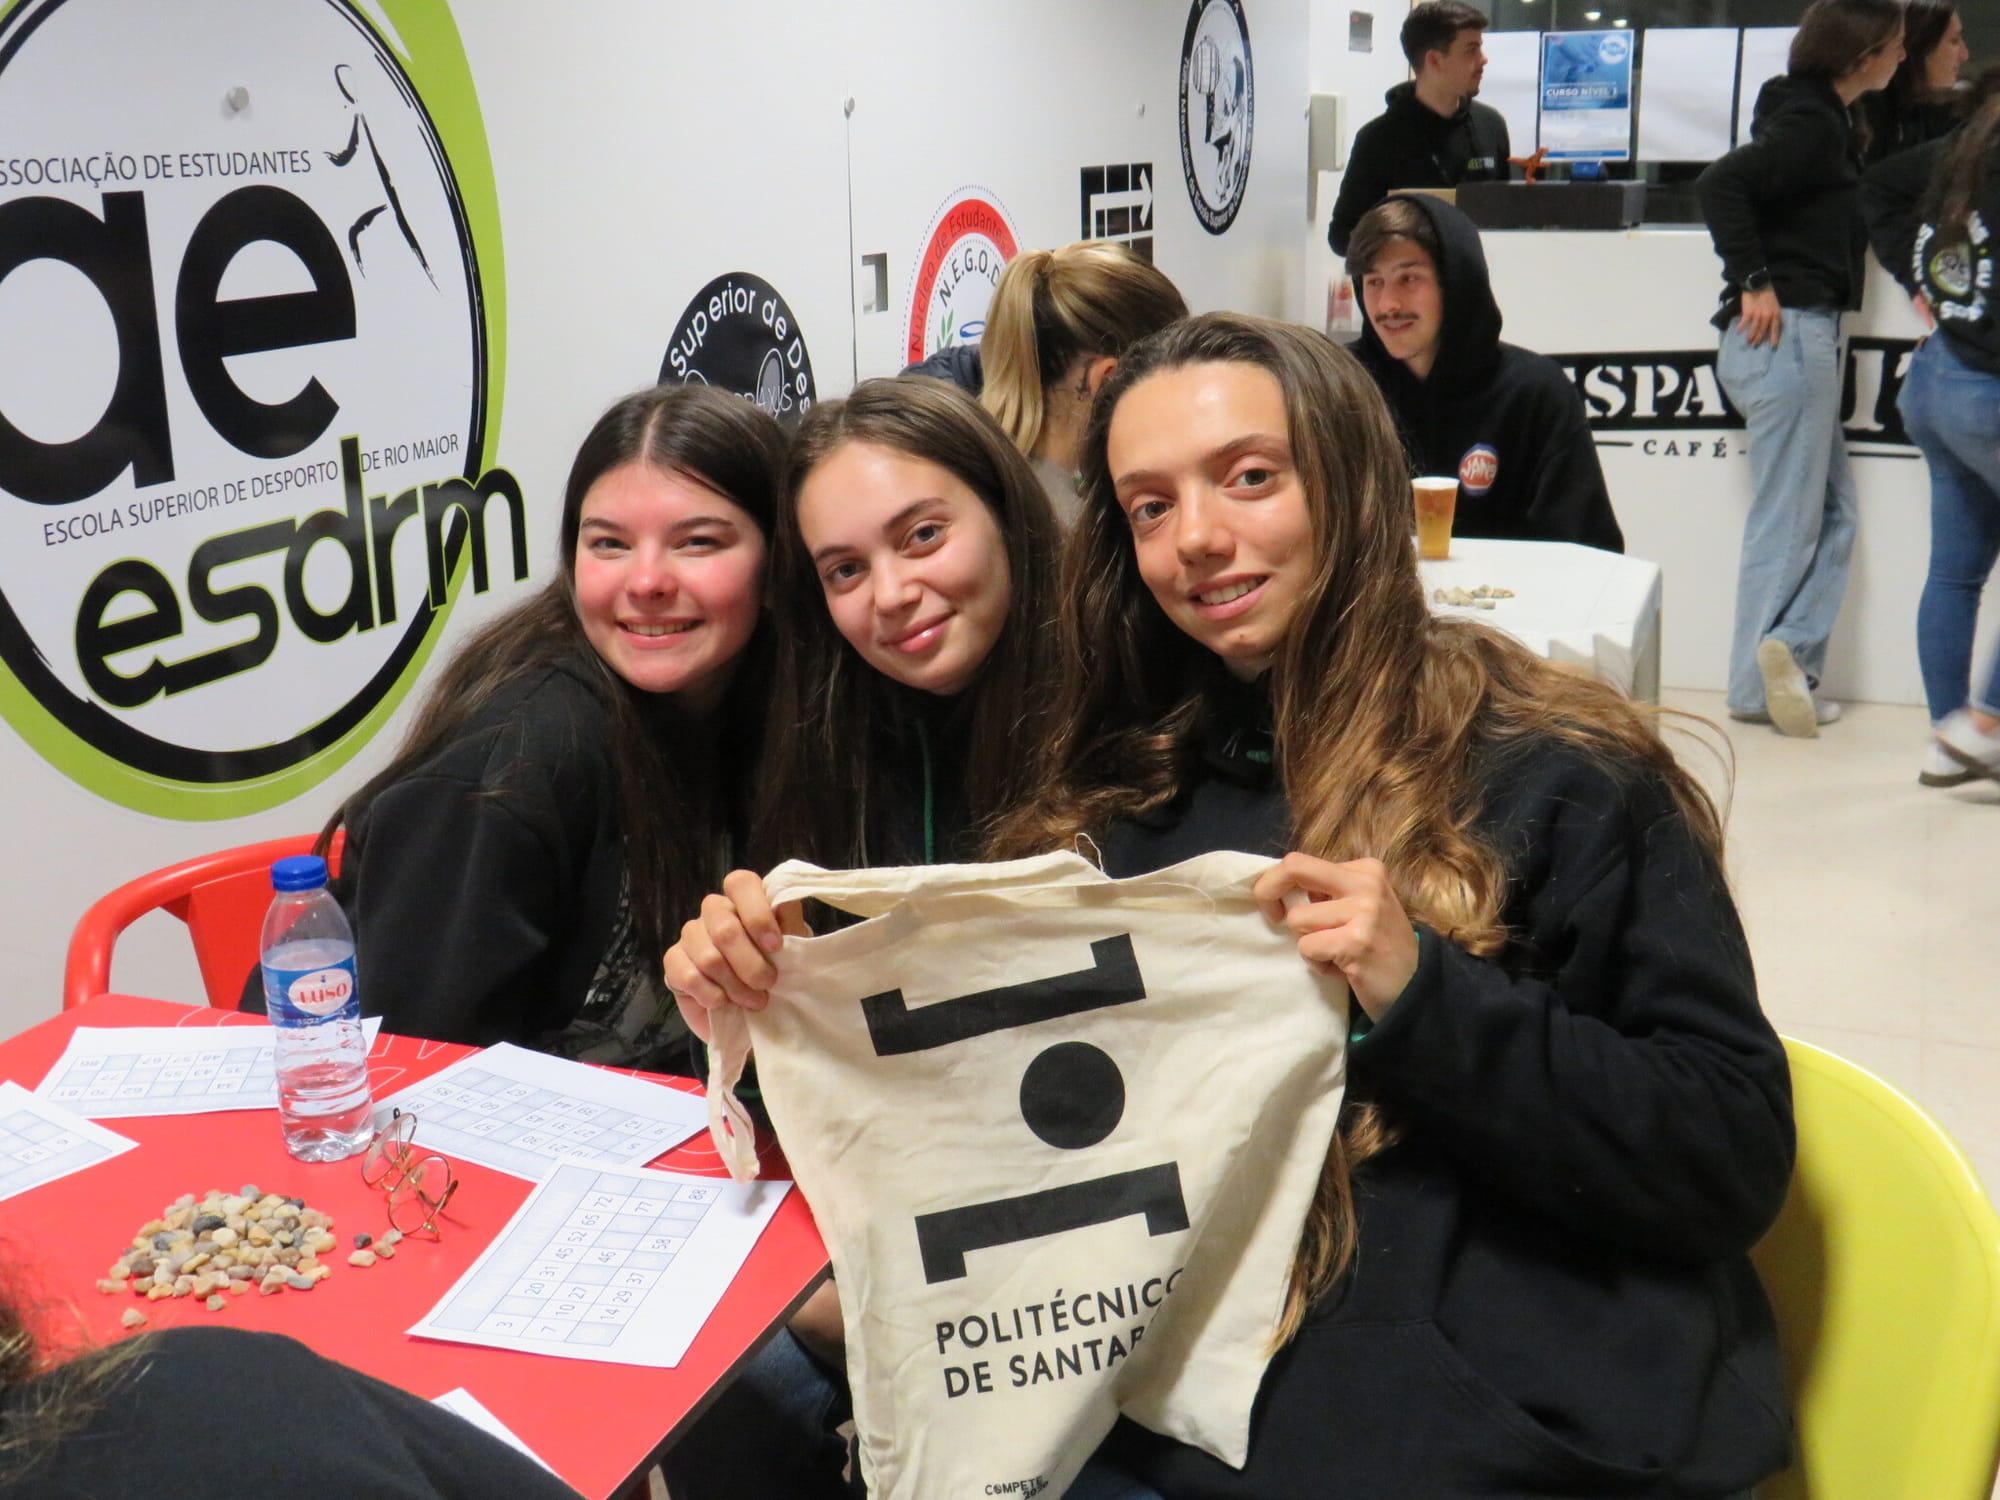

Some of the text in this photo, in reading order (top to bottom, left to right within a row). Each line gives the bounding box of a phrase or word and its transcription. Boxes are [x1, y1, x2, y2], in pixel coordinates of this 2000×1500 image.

[145, 156, 174, 178] DE
[180, 151, 311, 177] ESTUDANTES
[0, 184, 356, 506] ae
[671, 281, 811, 425] Superior de Des
[43, 433, 460, 546] ESCOLA SUPERIOR DE DESPORTO DE RIO MAIOR
[1643, 437, 1727, 458] CAFÉ
[75, 434, 529, 708] esdrm
[524, 1282, 544, 1295] 20
[539, 1266, 559, 1277] 31
[555, 1248, 573, 1259] 45
[567, 1231, 587, 1241] 52
[581, 1214, 600, 1226] 65
[593, 1196, 613, 1208] 72
[555, 1304, 575, 1315] 10
[568, 1286, 586, 1299] 27
[597, 1251, 616, 1263] 46
[634, 1201, 652, 1212] 77
[600, 1189, 706, 1320] 14 29 37 58 88
[944, 1366, 993, 1399] DE
